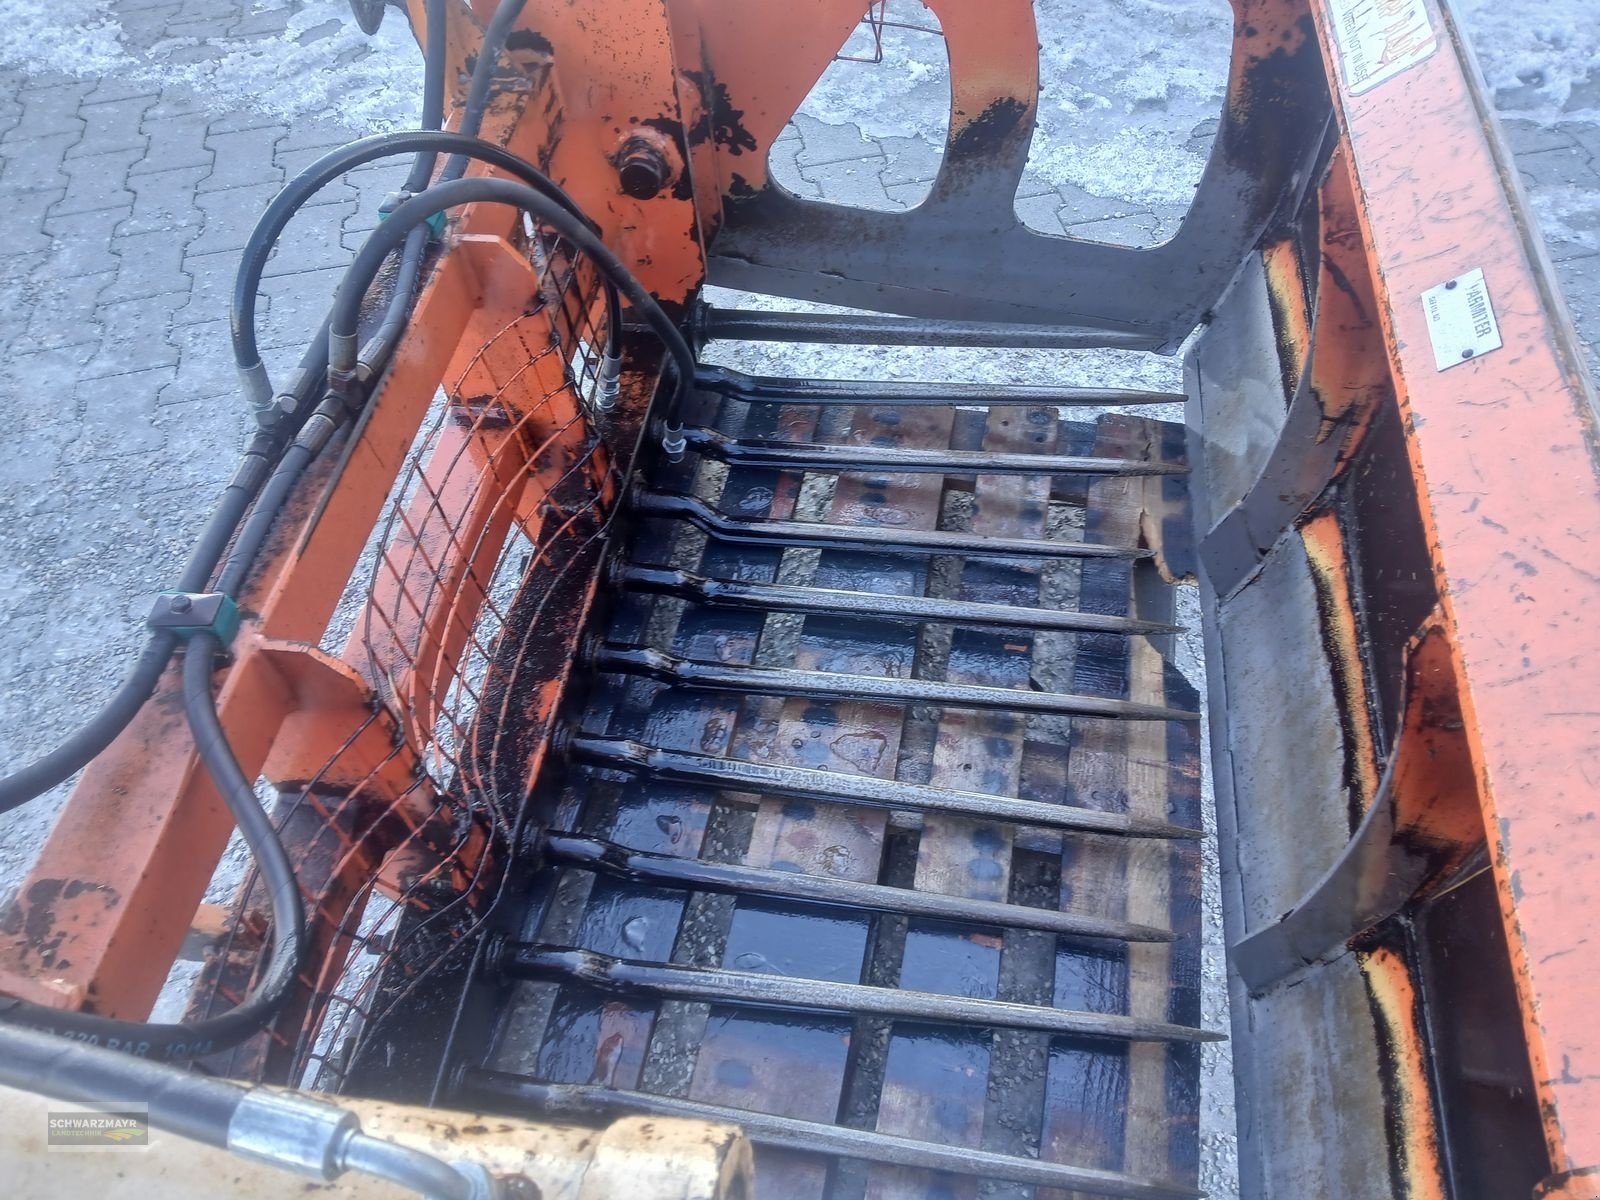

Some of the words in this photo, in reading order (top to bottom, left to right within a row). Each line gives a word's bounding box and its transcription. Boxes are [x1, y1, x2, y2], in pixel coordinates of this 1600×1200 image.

[1349, 34, 1362, 53] NOT
[1354, 62, 1369, 82] USE
[107, 1038, 151, 1057] BAR
